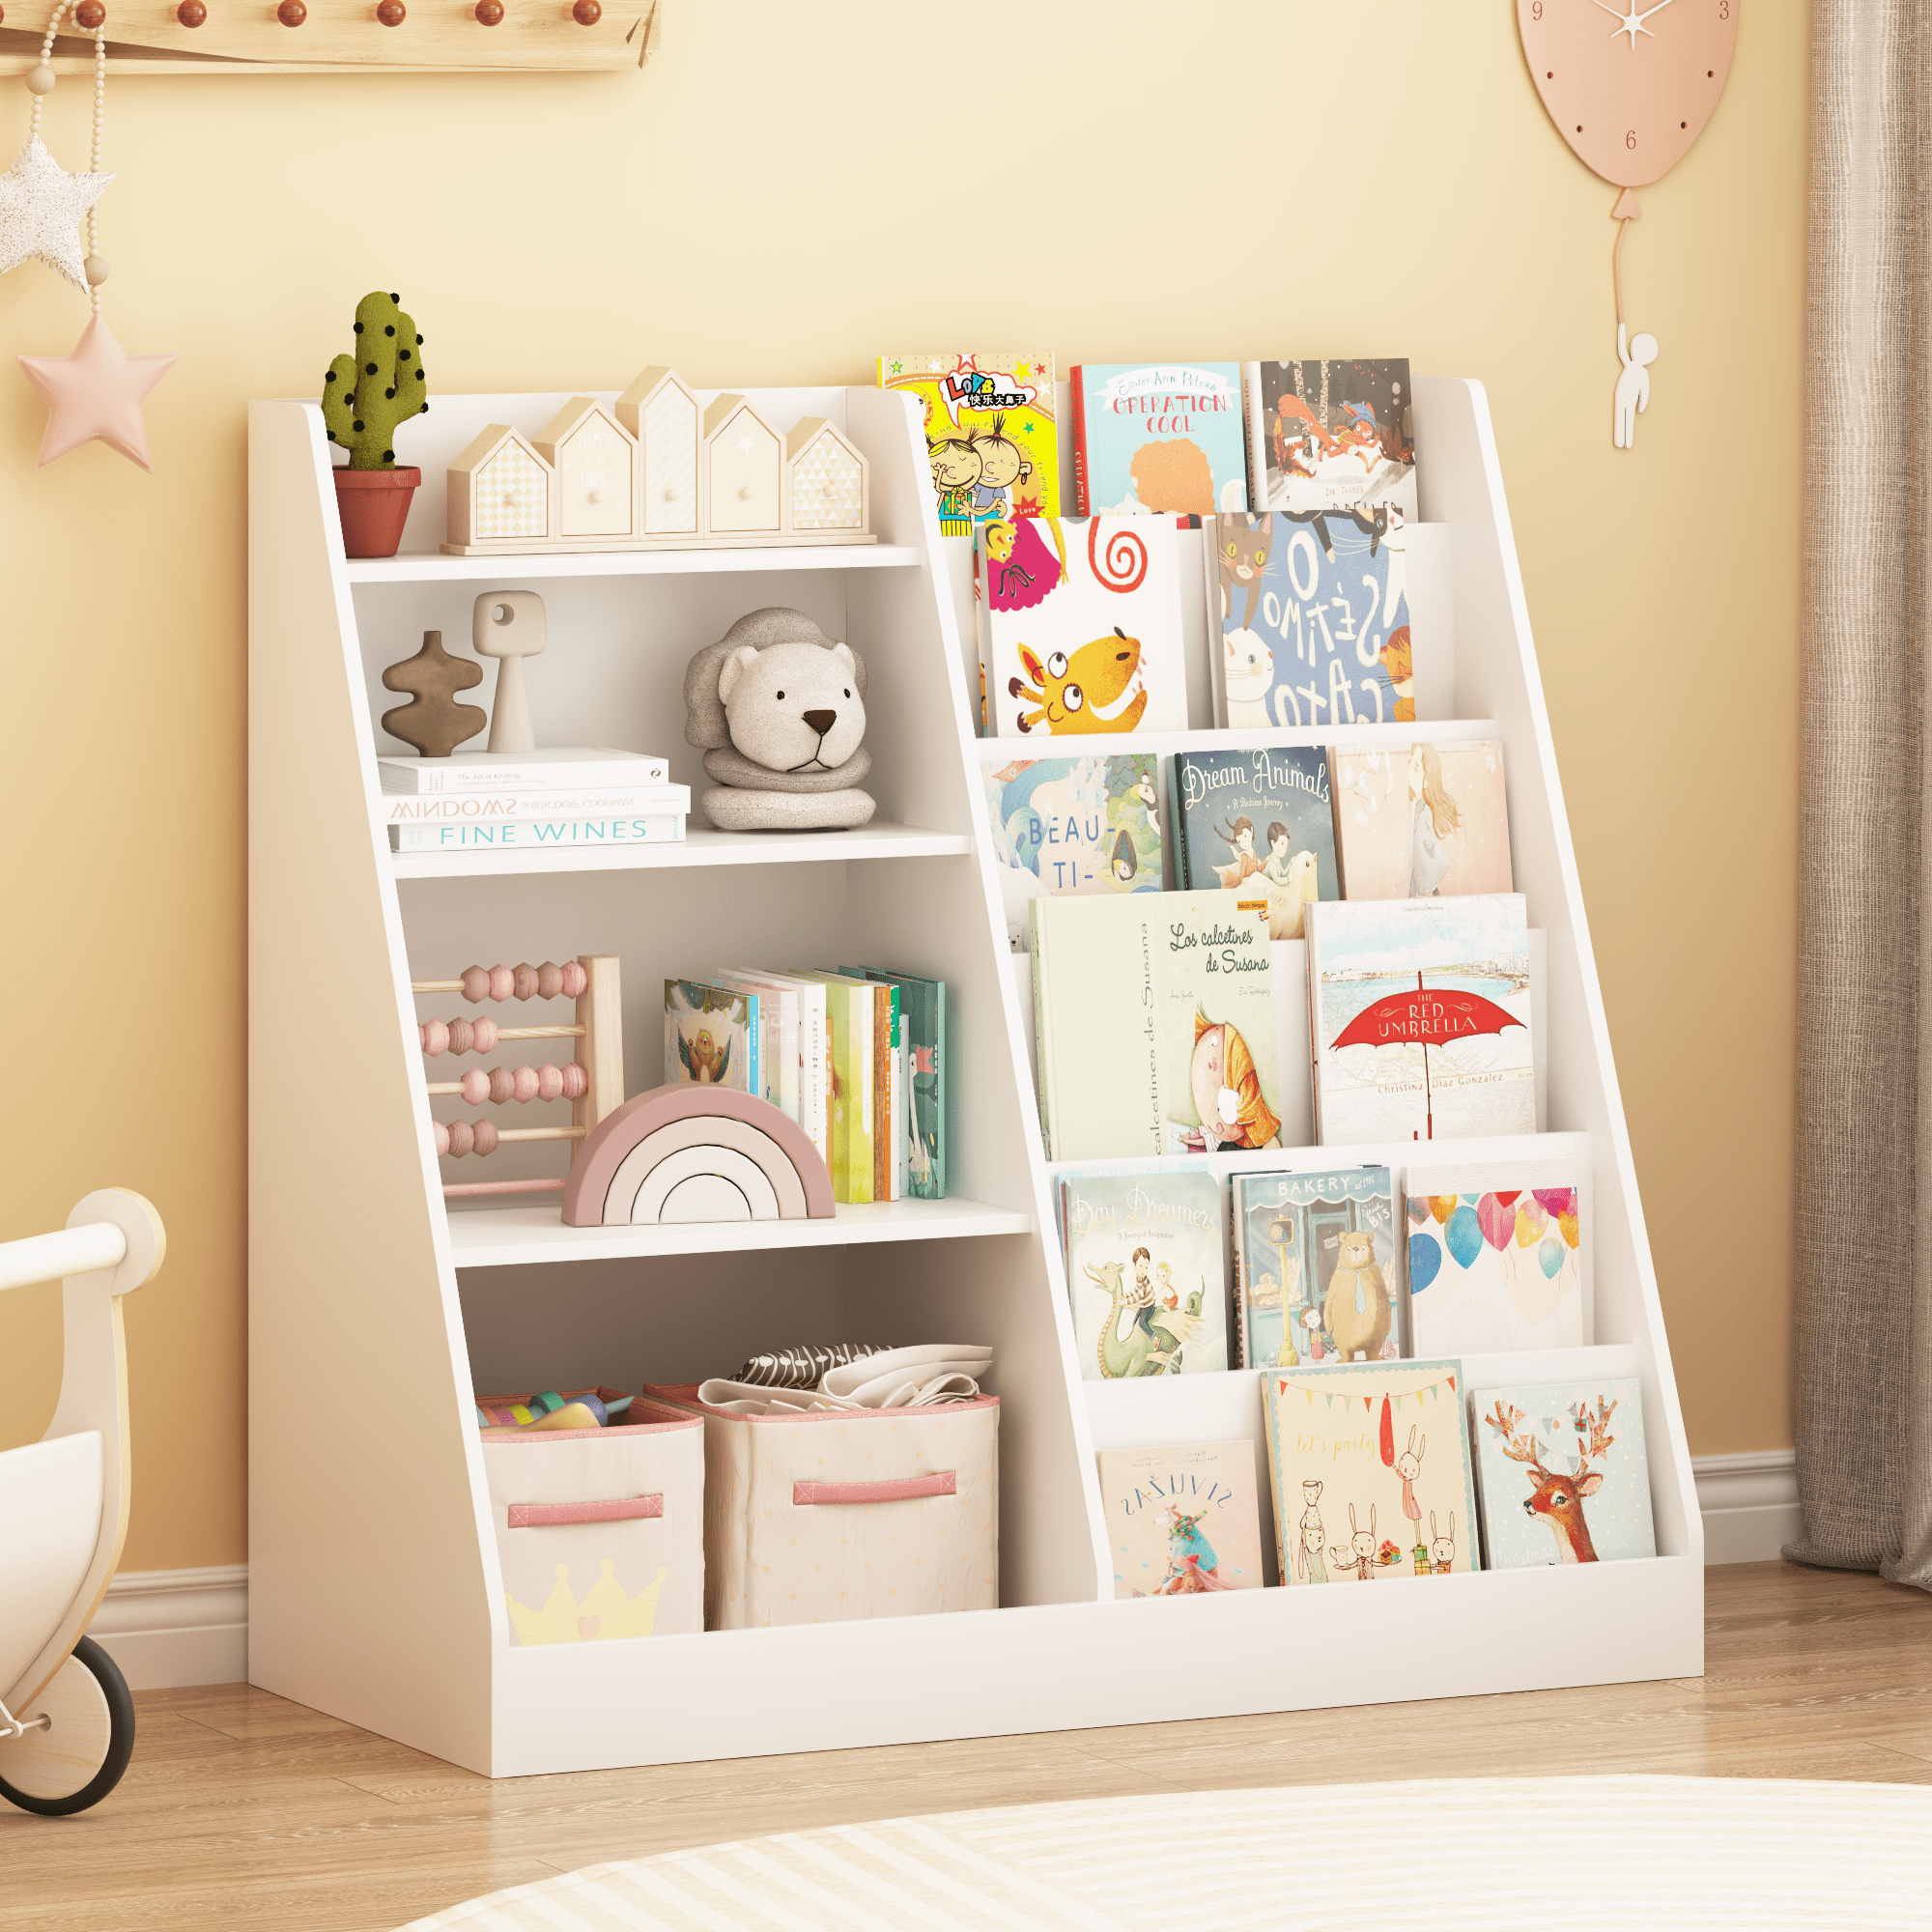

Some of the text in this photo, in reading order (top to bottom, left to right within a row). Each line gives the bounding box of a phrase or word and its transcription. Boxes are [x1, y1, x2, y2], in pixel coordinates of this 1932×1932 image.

[1532, 0, 1543, 20] 9
[1719, 0, 1729, 19] 3
[1626, 129, 1636, 150] 6
[1117, 377, 1151, 395] Easter
[969, 394, 1026, 407] 快乐大鼻子
[1113, 394, 1227, 414] OPERATION
[984, 421, 1020, 440] frend
[1147, 415, 1196, 434] COOL
[579, 432, 612, 450] HAPPY
[581, 470, 609, 488] HOME
[1019, 506, 1037, 515] Love
[1181, 749, 1329, 810] Dream Animals
[440, 819, 647, 846] FINE WINES
[1029, 814, 1116, 845] BEAU-
[1053, 861, 1094, 888] TI-
[1170, 923, 1254, 952] Los calcetines
[1206, 949, 1269, 974] de Susana
[1417, 993, 1435, 1003] THE
[1408, 1003, 1444, 1019] RED
[1378, 1016, 1477, 1038] UMBRELLA
[1141, 923, 1161, 1155] calcetines de Susana
[1378, 1082, 1423, 1094] Christina
[1278, 1177, 1350, 1197] BAKERY
[1071, 1182, 1215, 1239] Day Dreamers
[1296, 1433, 1377, 1462] let's party
[1493, 1545, 1555, 1569] Christmas
